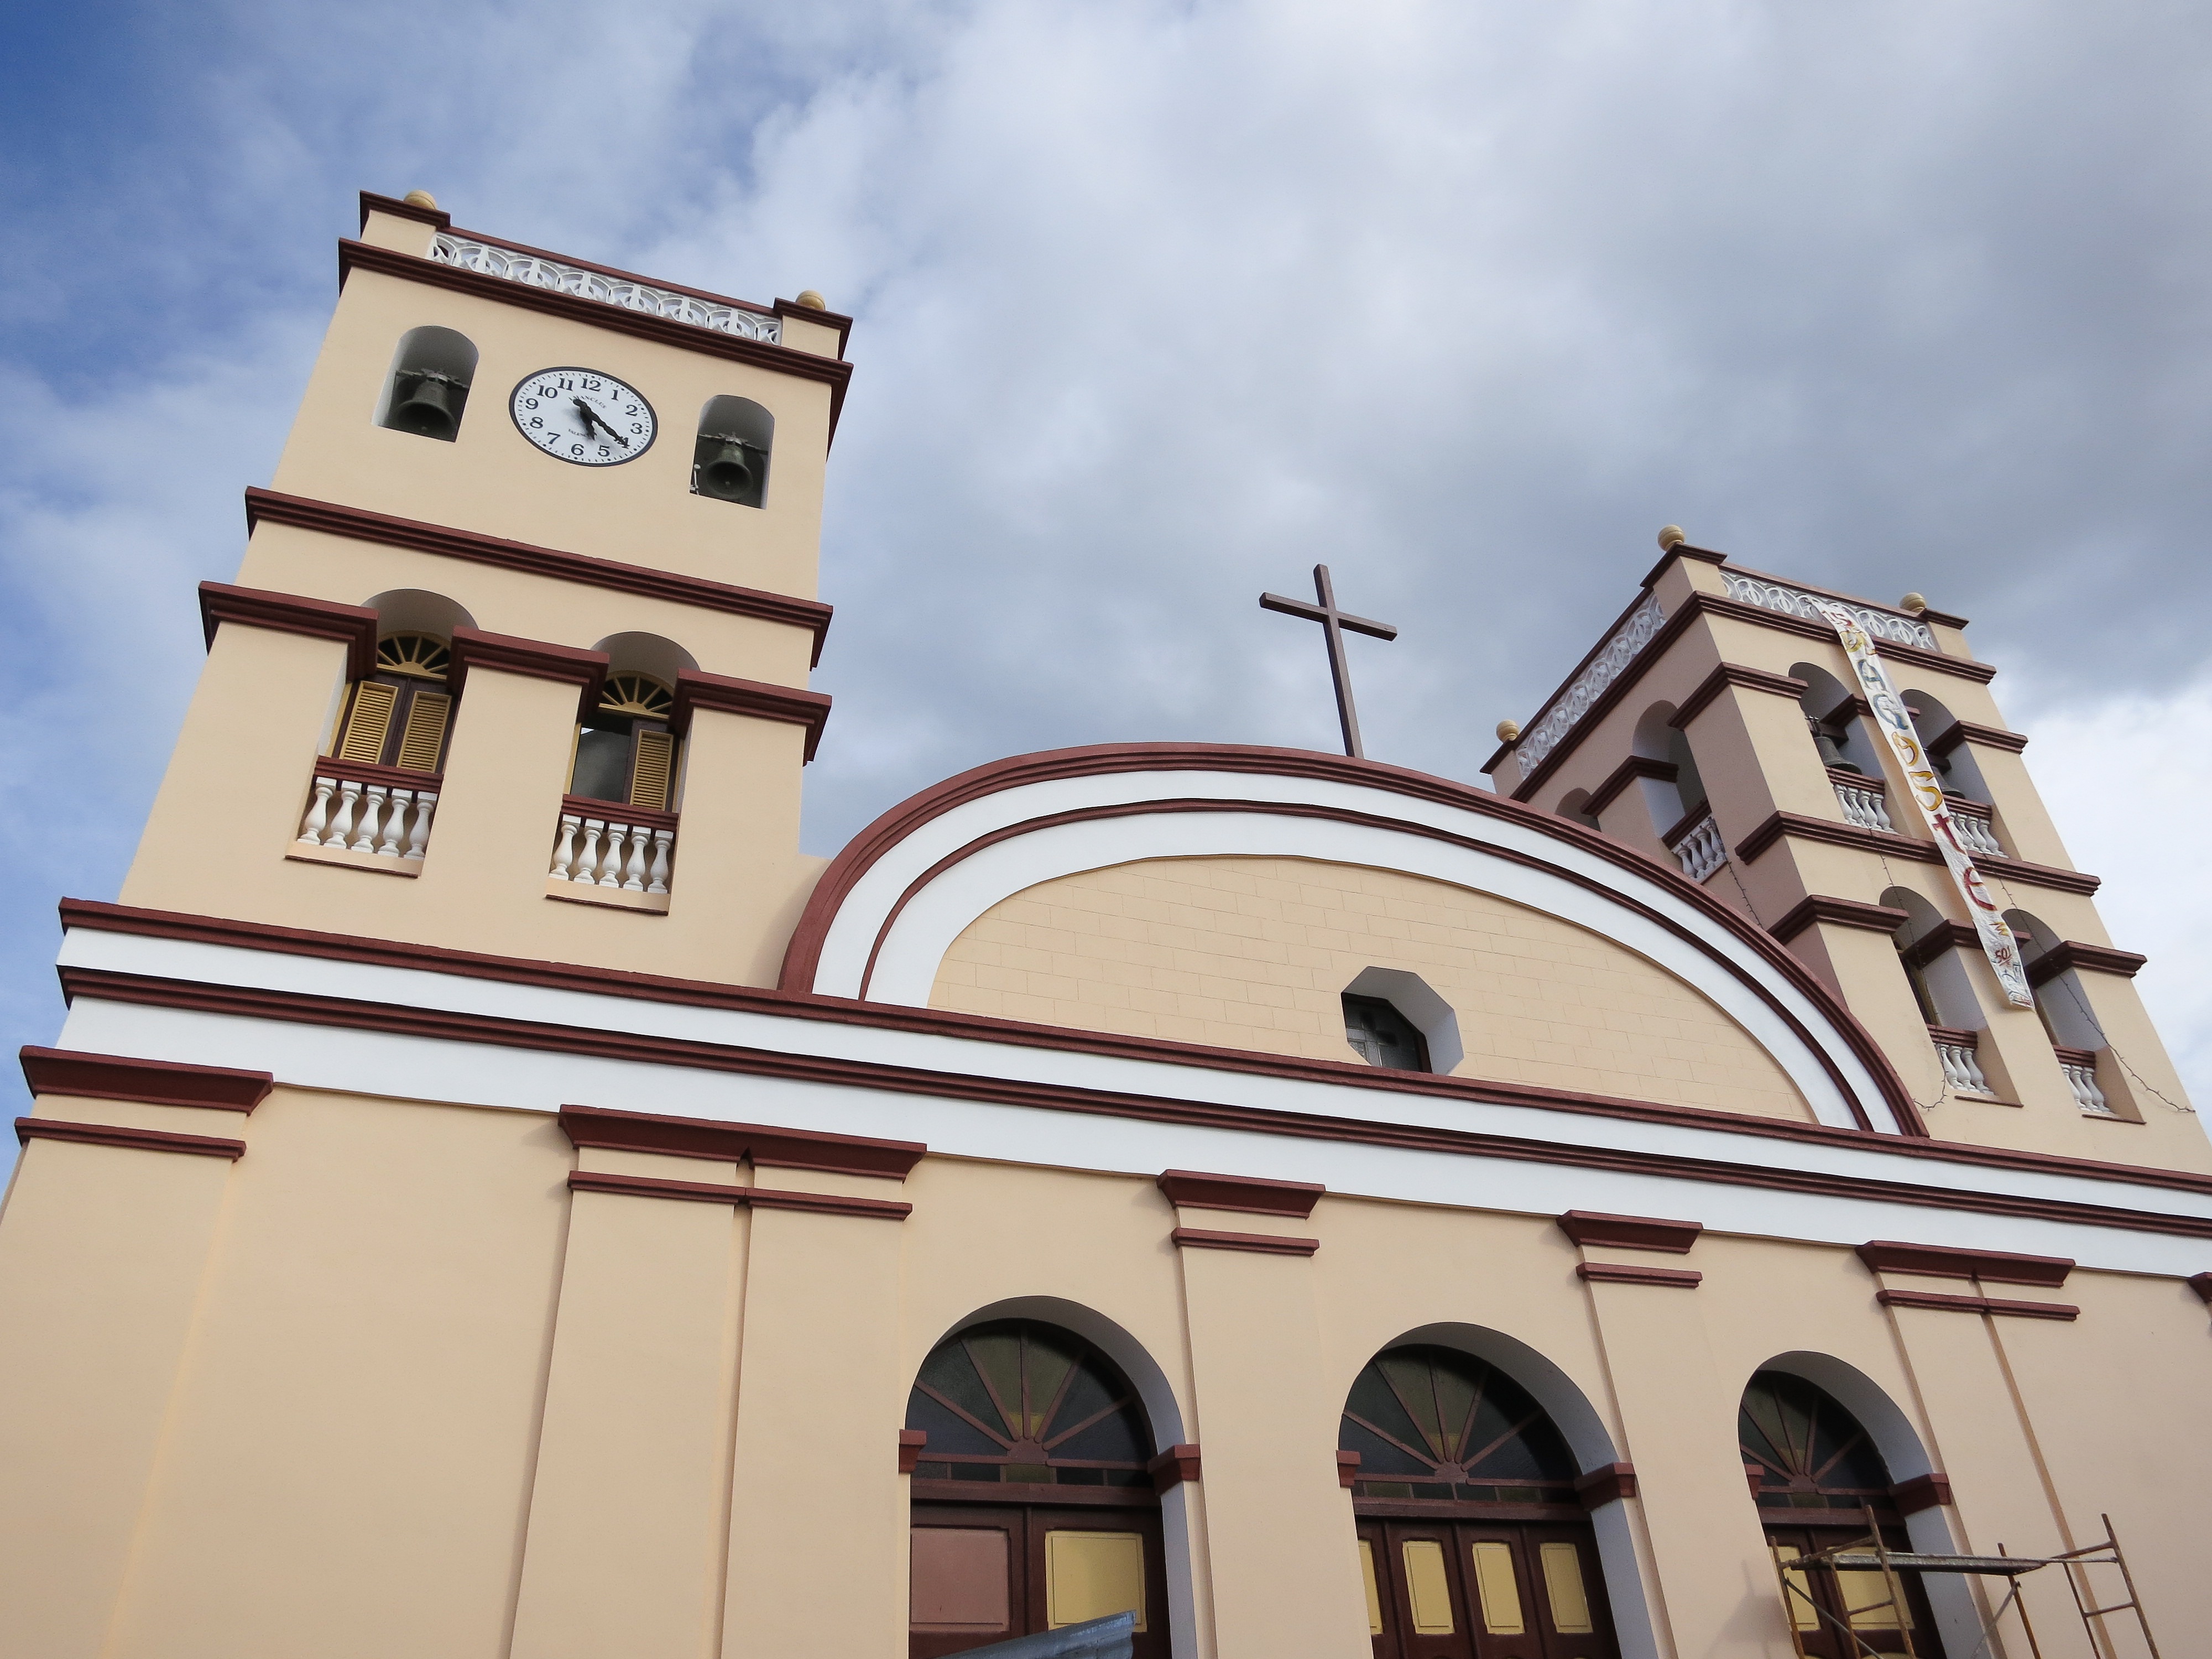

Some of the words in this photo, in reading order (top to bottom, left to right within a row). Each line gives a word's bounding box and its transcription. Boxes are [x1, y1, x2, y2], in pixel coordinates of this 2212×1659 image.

[558, 378, 574, 391] 11
[581, 378, 601, 392] 12
[536, 385, 557, 398] 10
[611, 389, 619, 401] 1
[525, 398, 538, 410] 9
[625, 404, 638, 416] 2
[530, 417, 544, 429] 8
[630, 422, 643, 435] 3
[547, 432, 561, 445] 7
[617, 437, 630, 449] 4
[571, 444, 584, 456] 6
[598, 445, 609, 457] 5
